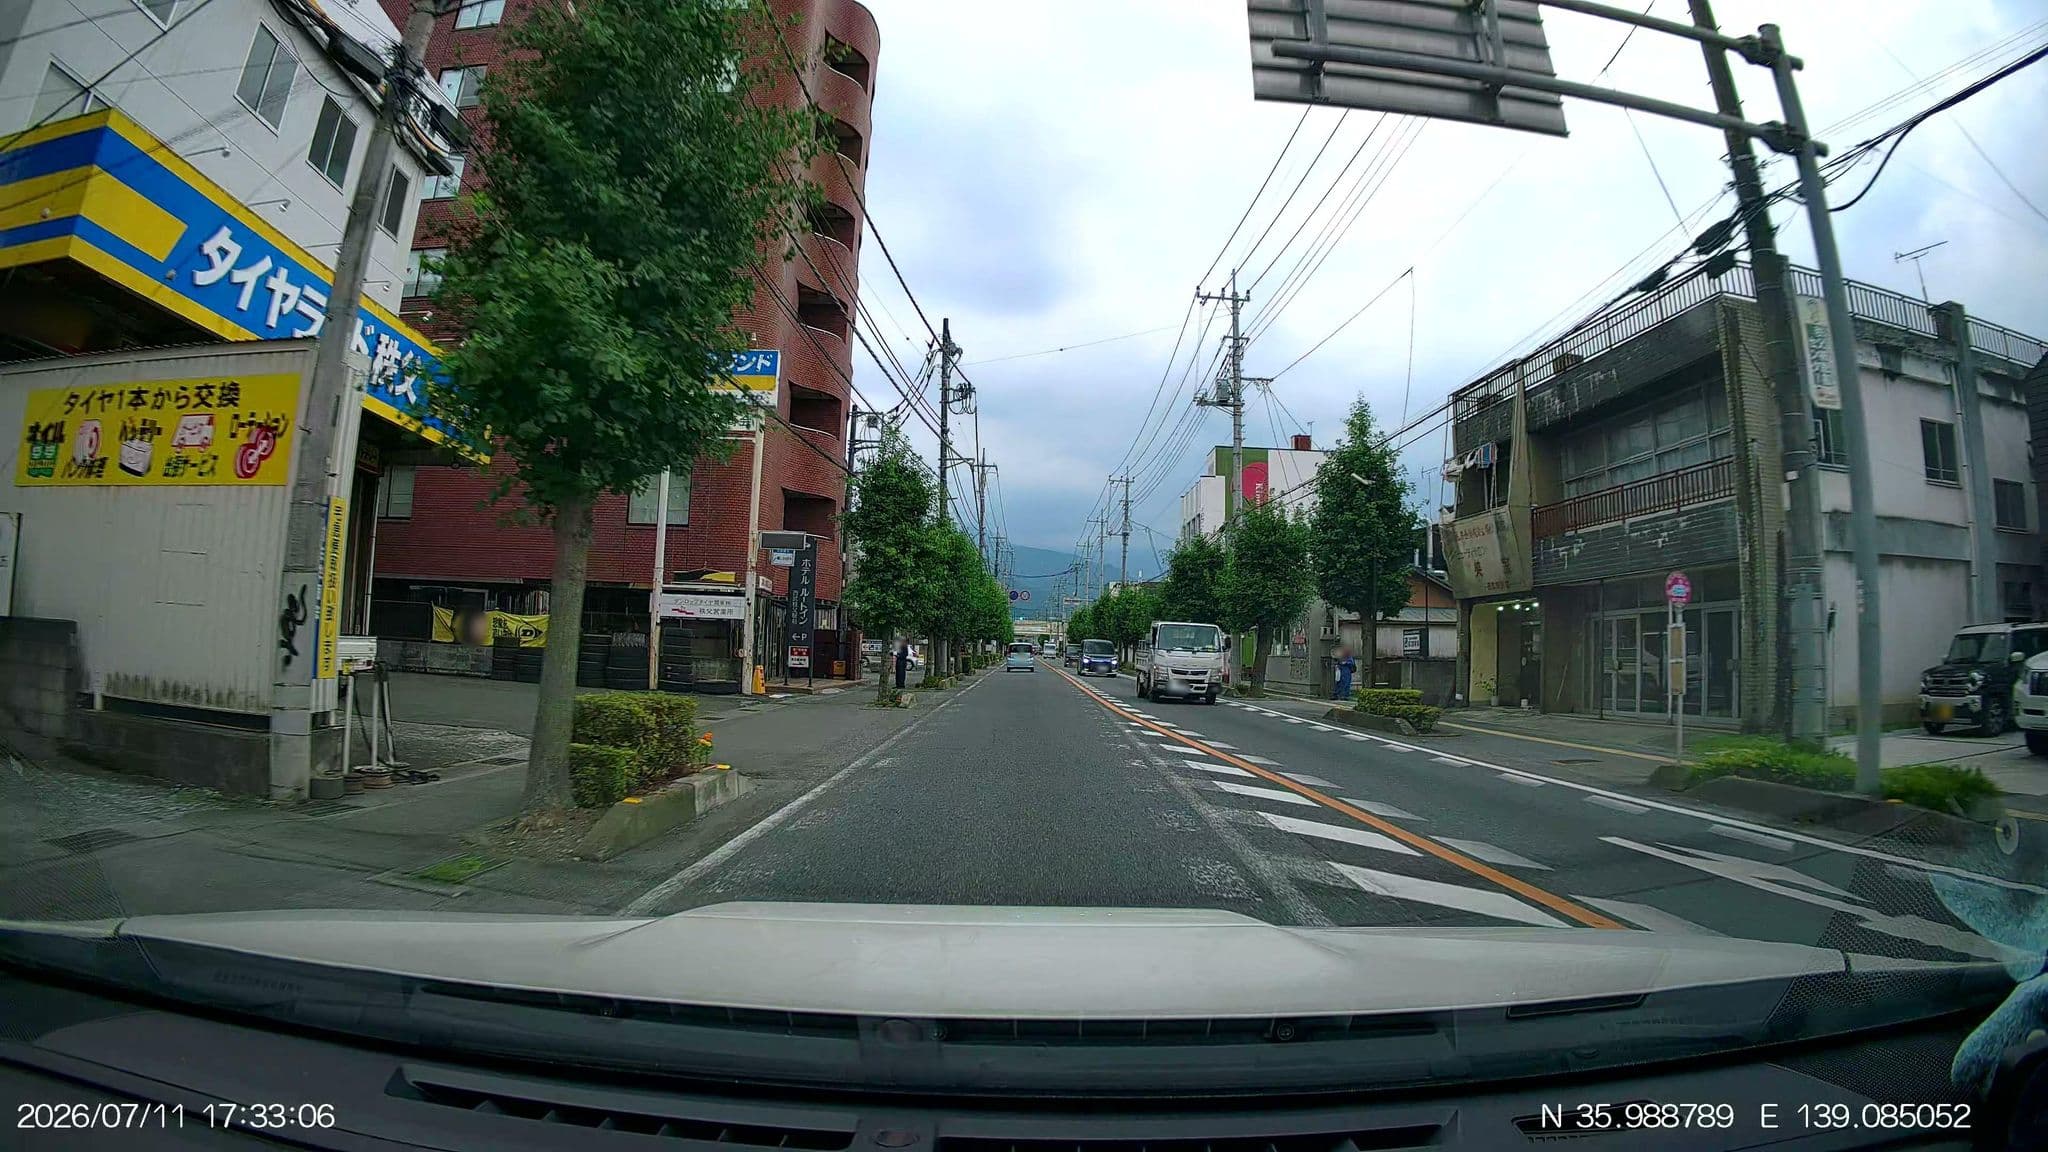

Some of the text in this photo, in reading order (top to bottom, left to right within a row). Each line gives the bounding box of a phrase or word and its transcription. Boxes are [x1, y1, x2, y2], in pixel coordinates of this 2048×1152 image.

[192, 225, 423, 405] タイヤラド秩父
[726, 354, 774, 372] ンド
[64, 382, 241, 415] タイヤ1本から交換
[798, 558, 812, 626] ホテル ルートイン
[699, 607, 734, 616] 秩父営業所
[801, 633, 808, 641] P
